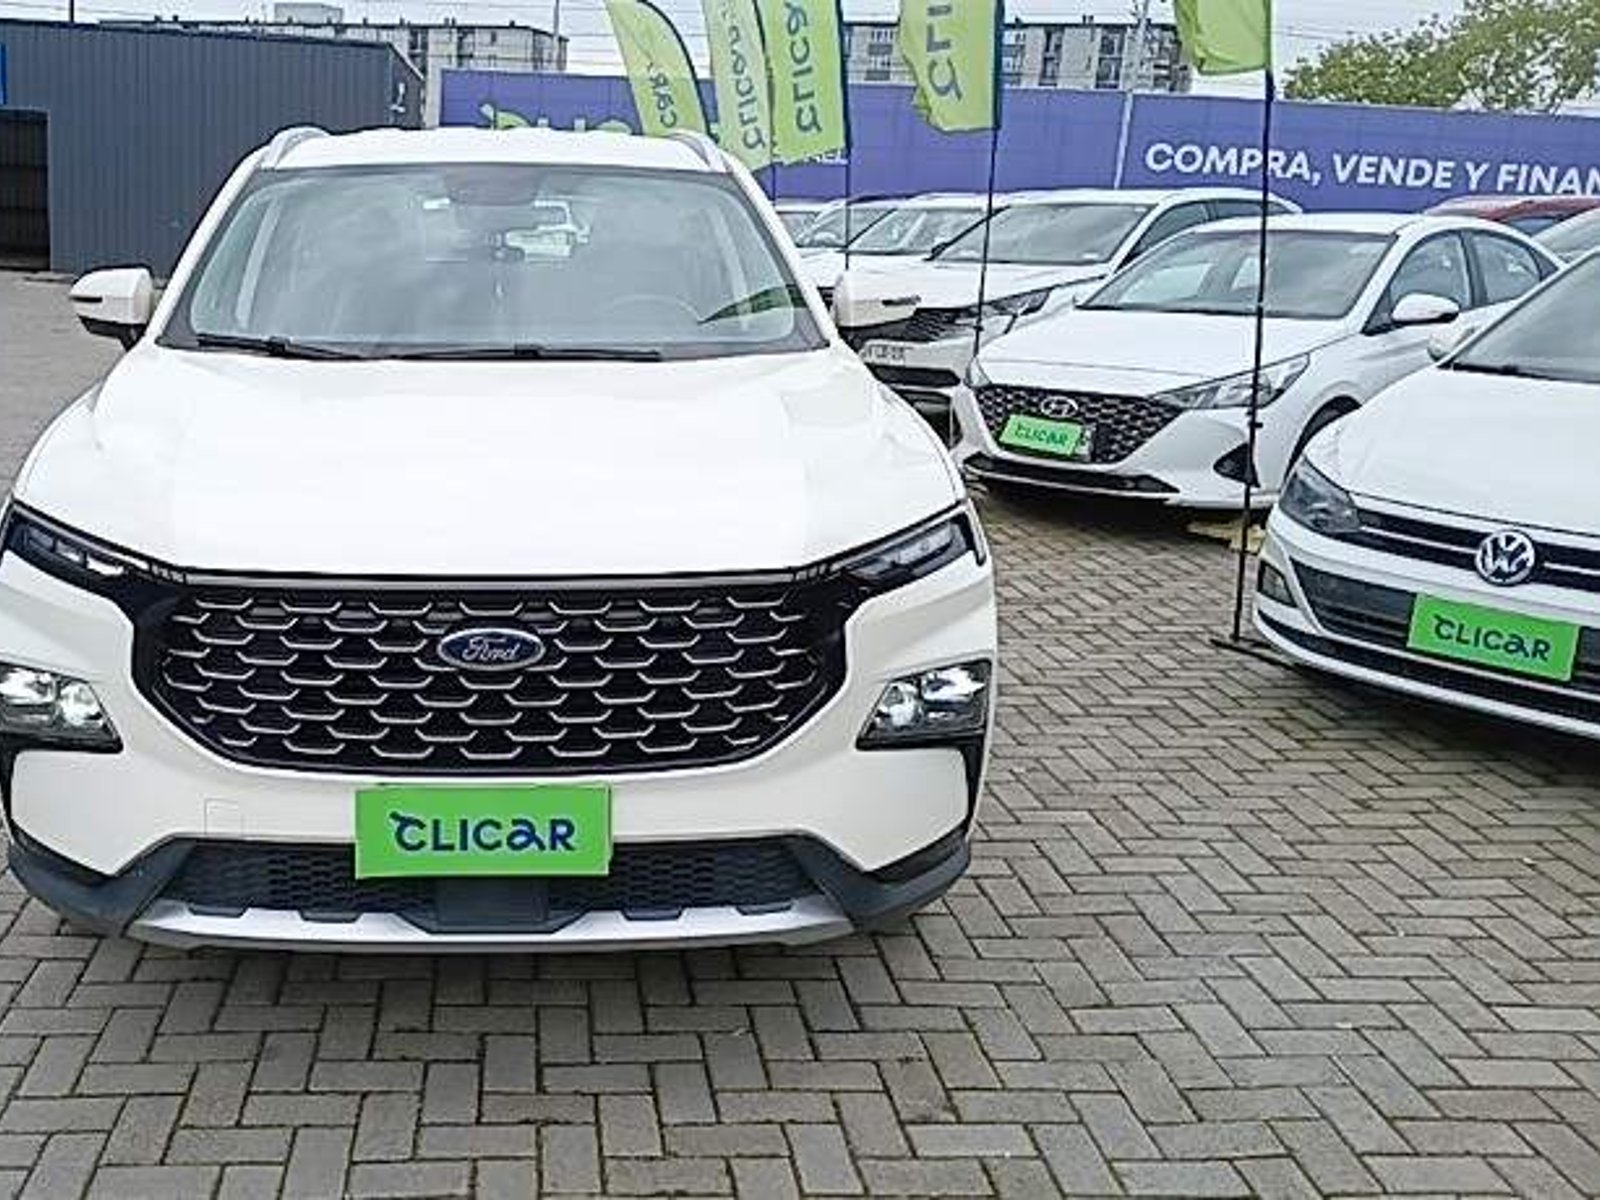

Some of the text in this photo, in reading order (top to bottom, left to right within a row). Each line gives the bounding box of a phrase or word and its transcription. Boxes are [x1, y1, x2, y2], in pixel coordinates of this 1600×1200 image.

[1144, 142, 1321, 186] COMPRA,
[1332, 153, 1456, 189] VENDE
[1466, 161, 1490, 190] Y
[461, 635, 521, 661] Ford
